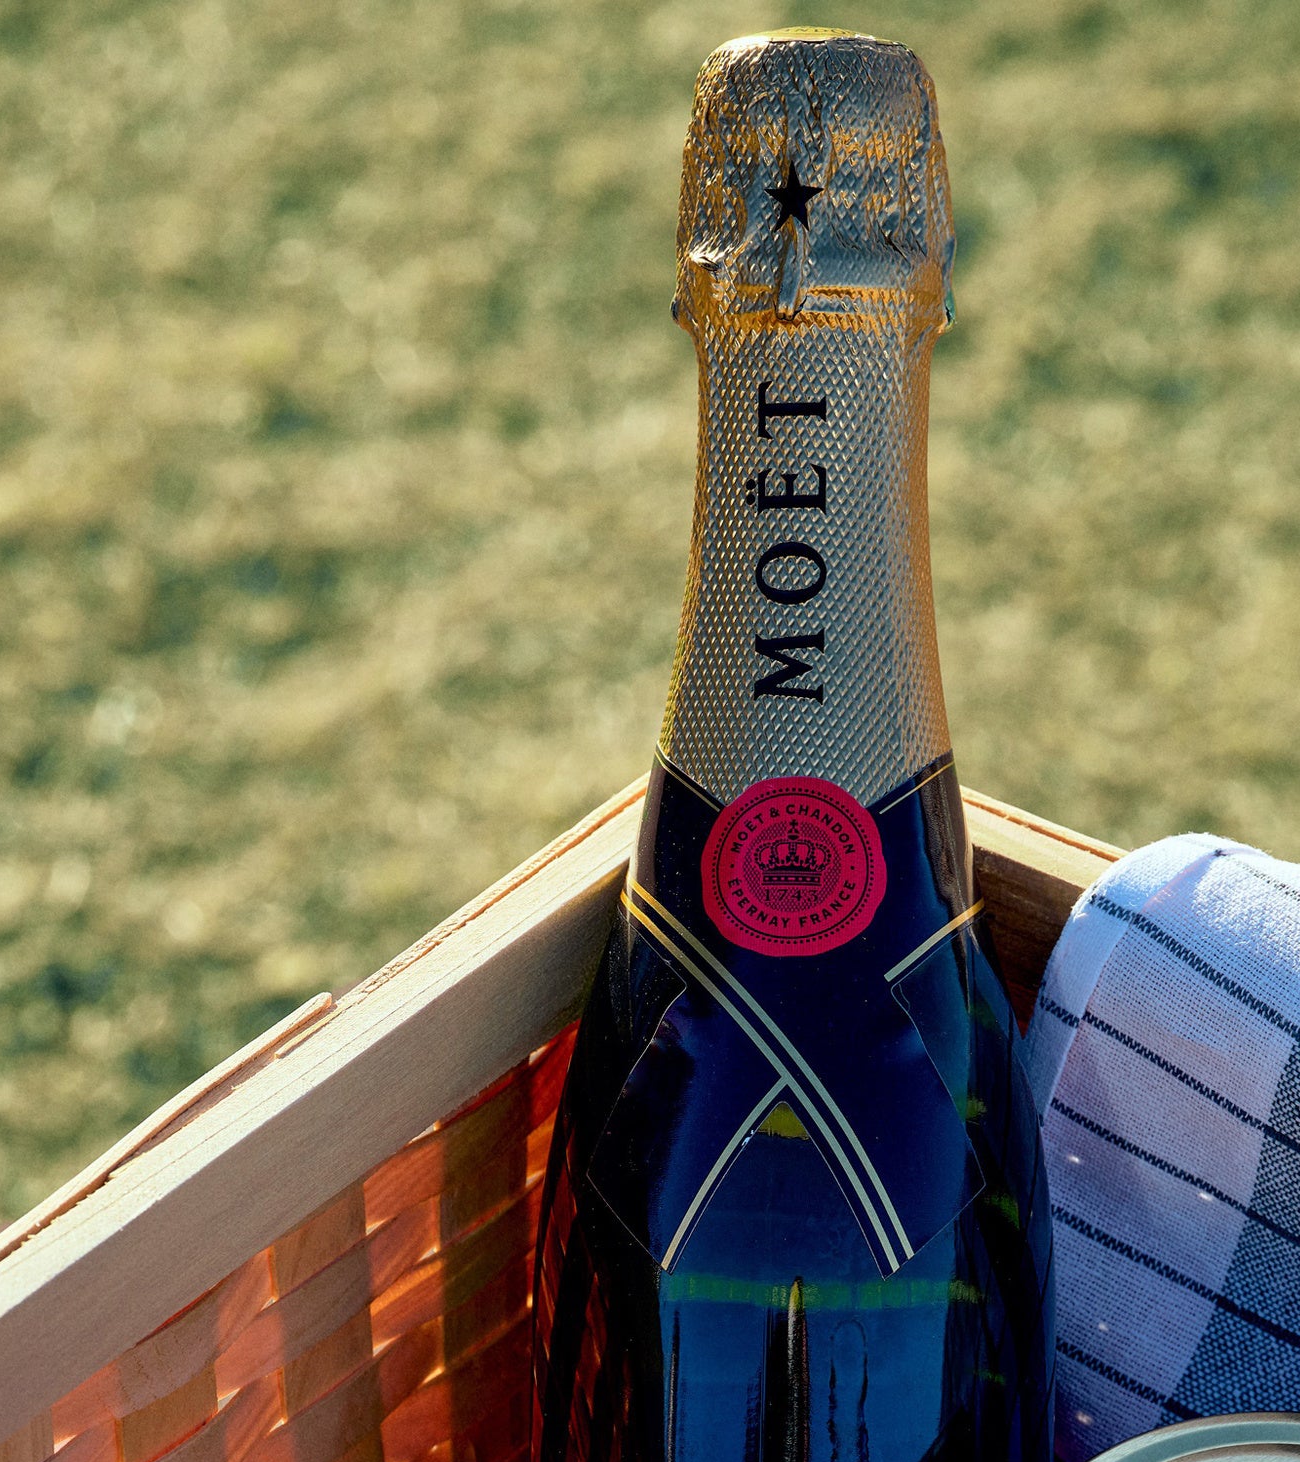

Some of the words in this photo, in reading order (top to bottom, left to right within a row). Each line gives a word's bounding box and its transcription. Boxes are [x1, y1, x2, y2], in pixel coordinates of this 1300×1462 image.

[746, 381, 829, 705] MOËT
[730, 813, 765, 854] MOËT
[770, 807, 781, 819] &
[785, 803, 856, 855] CHANDON
[764, 888, 819, 902] 1743
[798, 881, 856, 929] FRANCE
